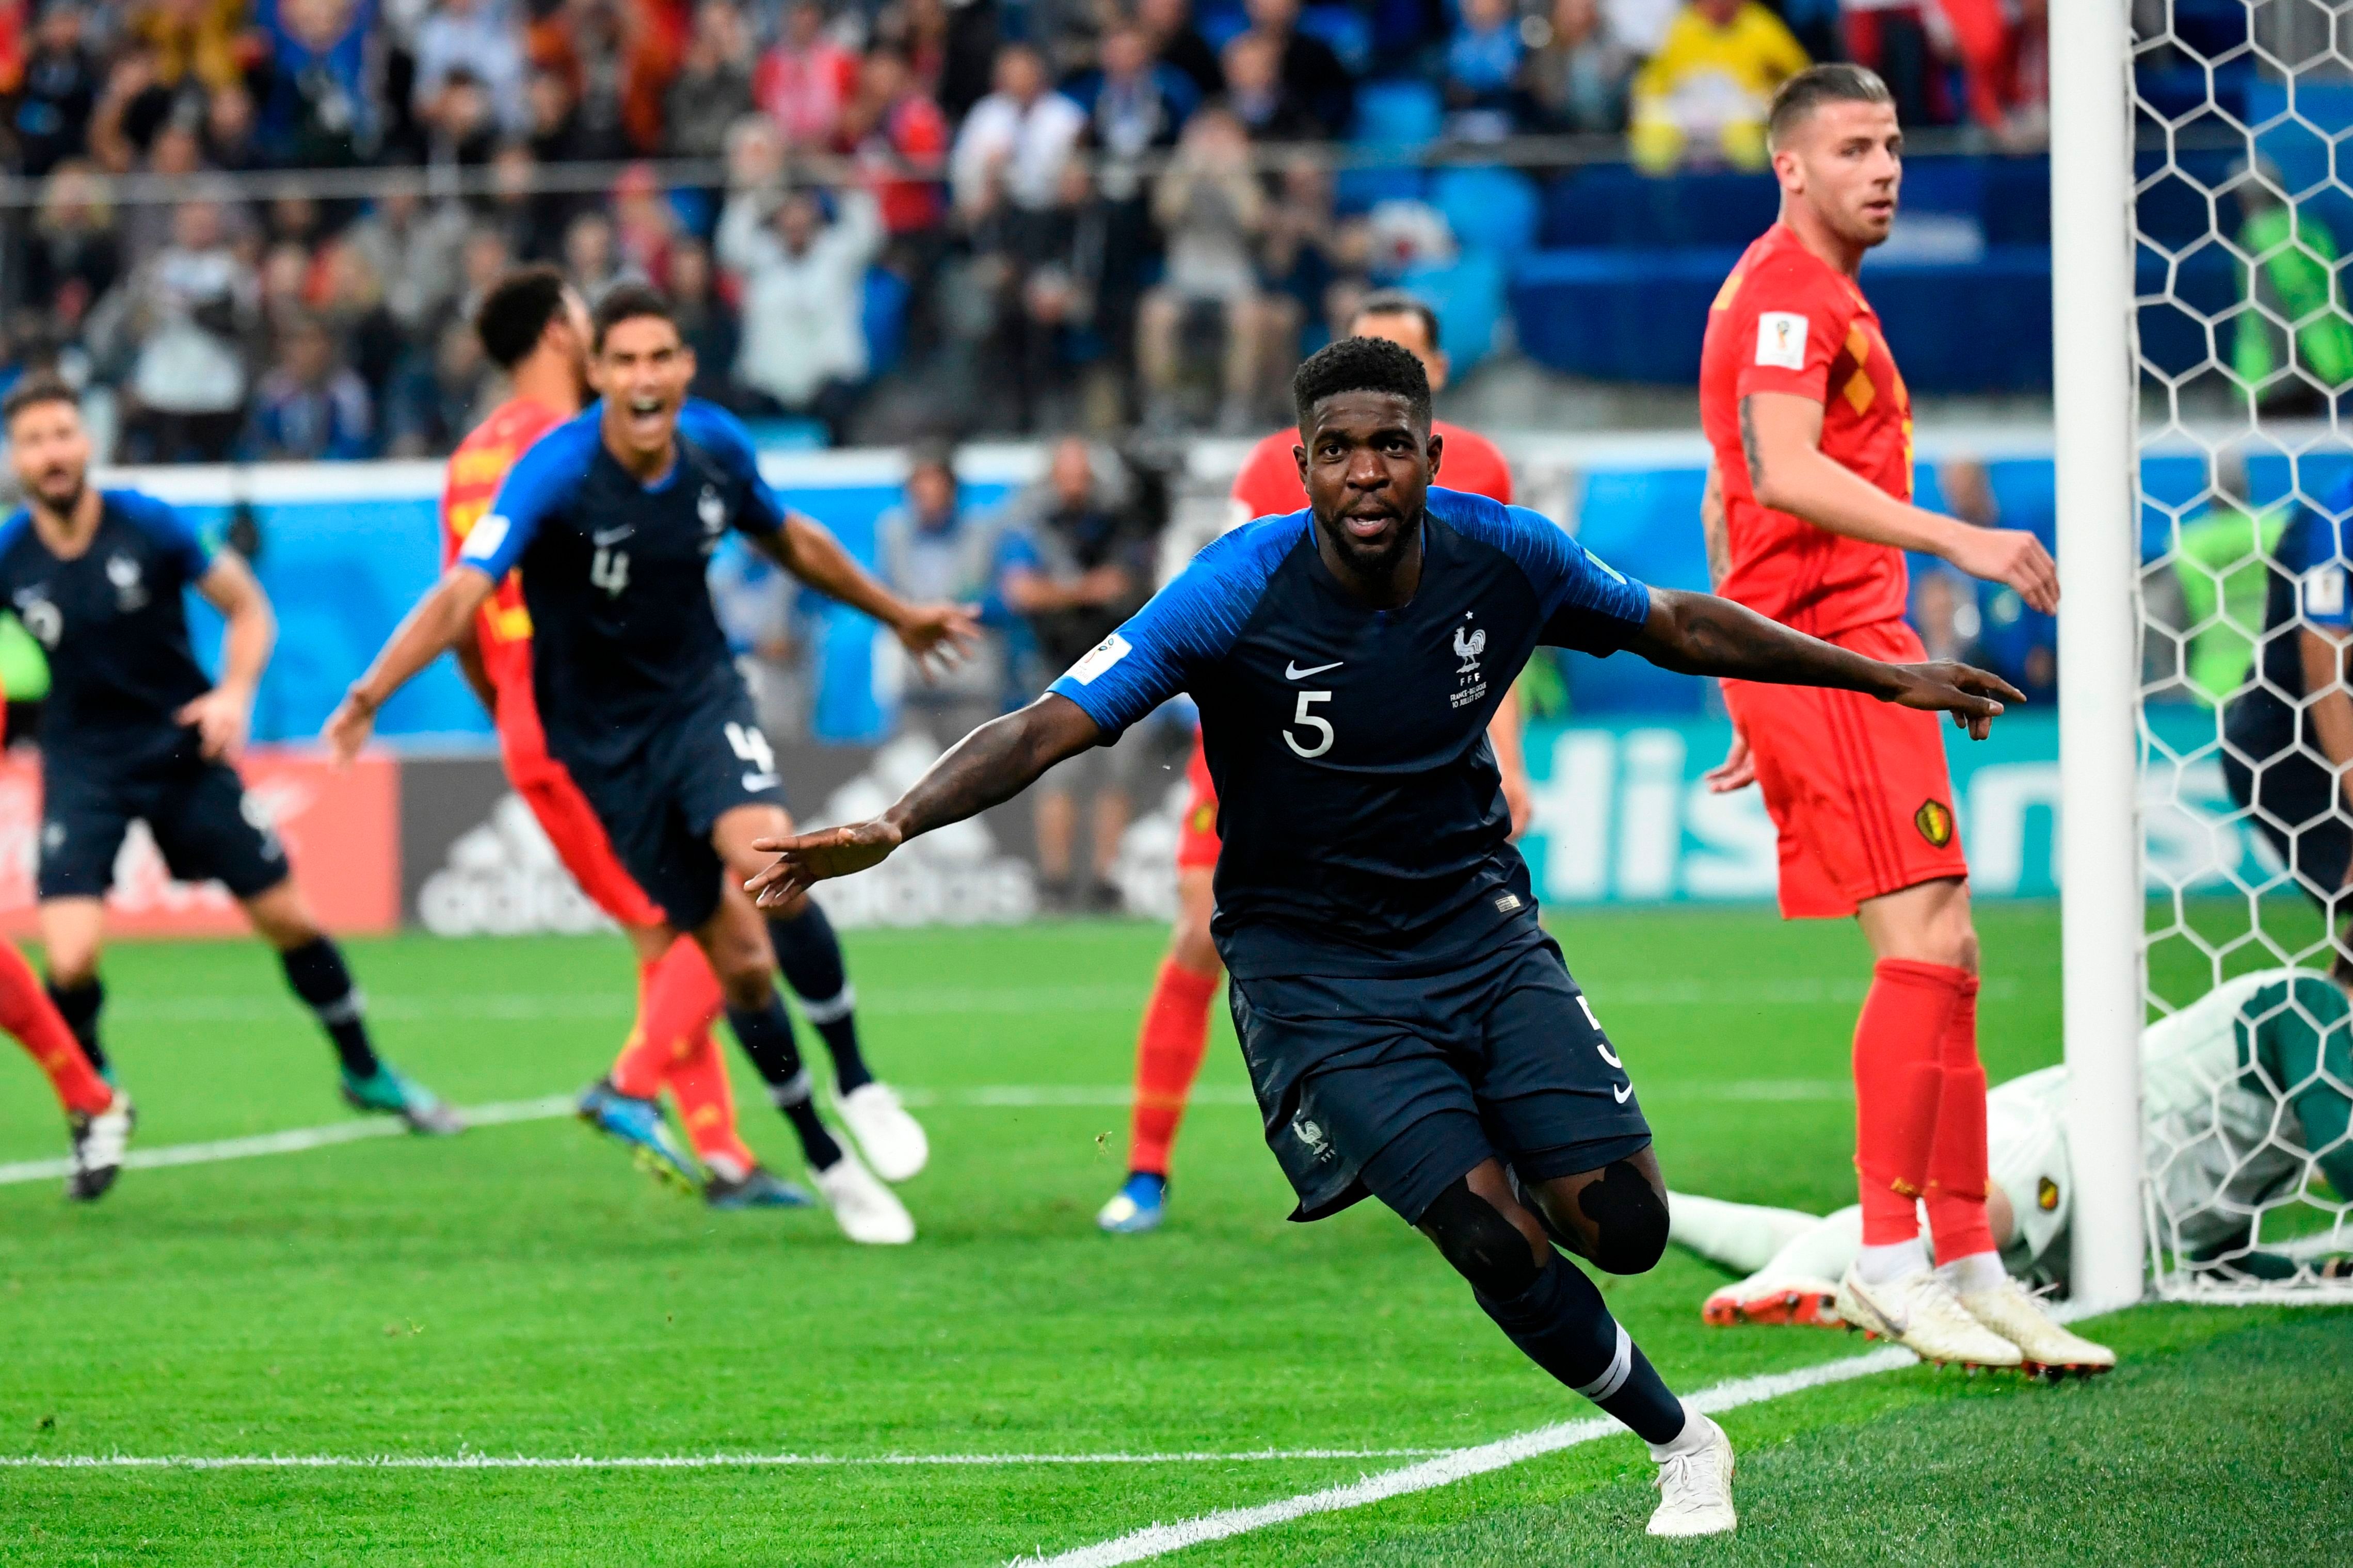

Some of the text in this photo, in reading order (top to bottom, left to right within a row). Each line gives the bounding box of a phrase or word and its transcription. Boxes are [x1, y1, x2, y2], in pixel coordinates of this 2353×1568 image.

[590, 548, 630, 596] 4
[724, 721, 775, 773] 4
[1283, 691, 1334, 758] 5
